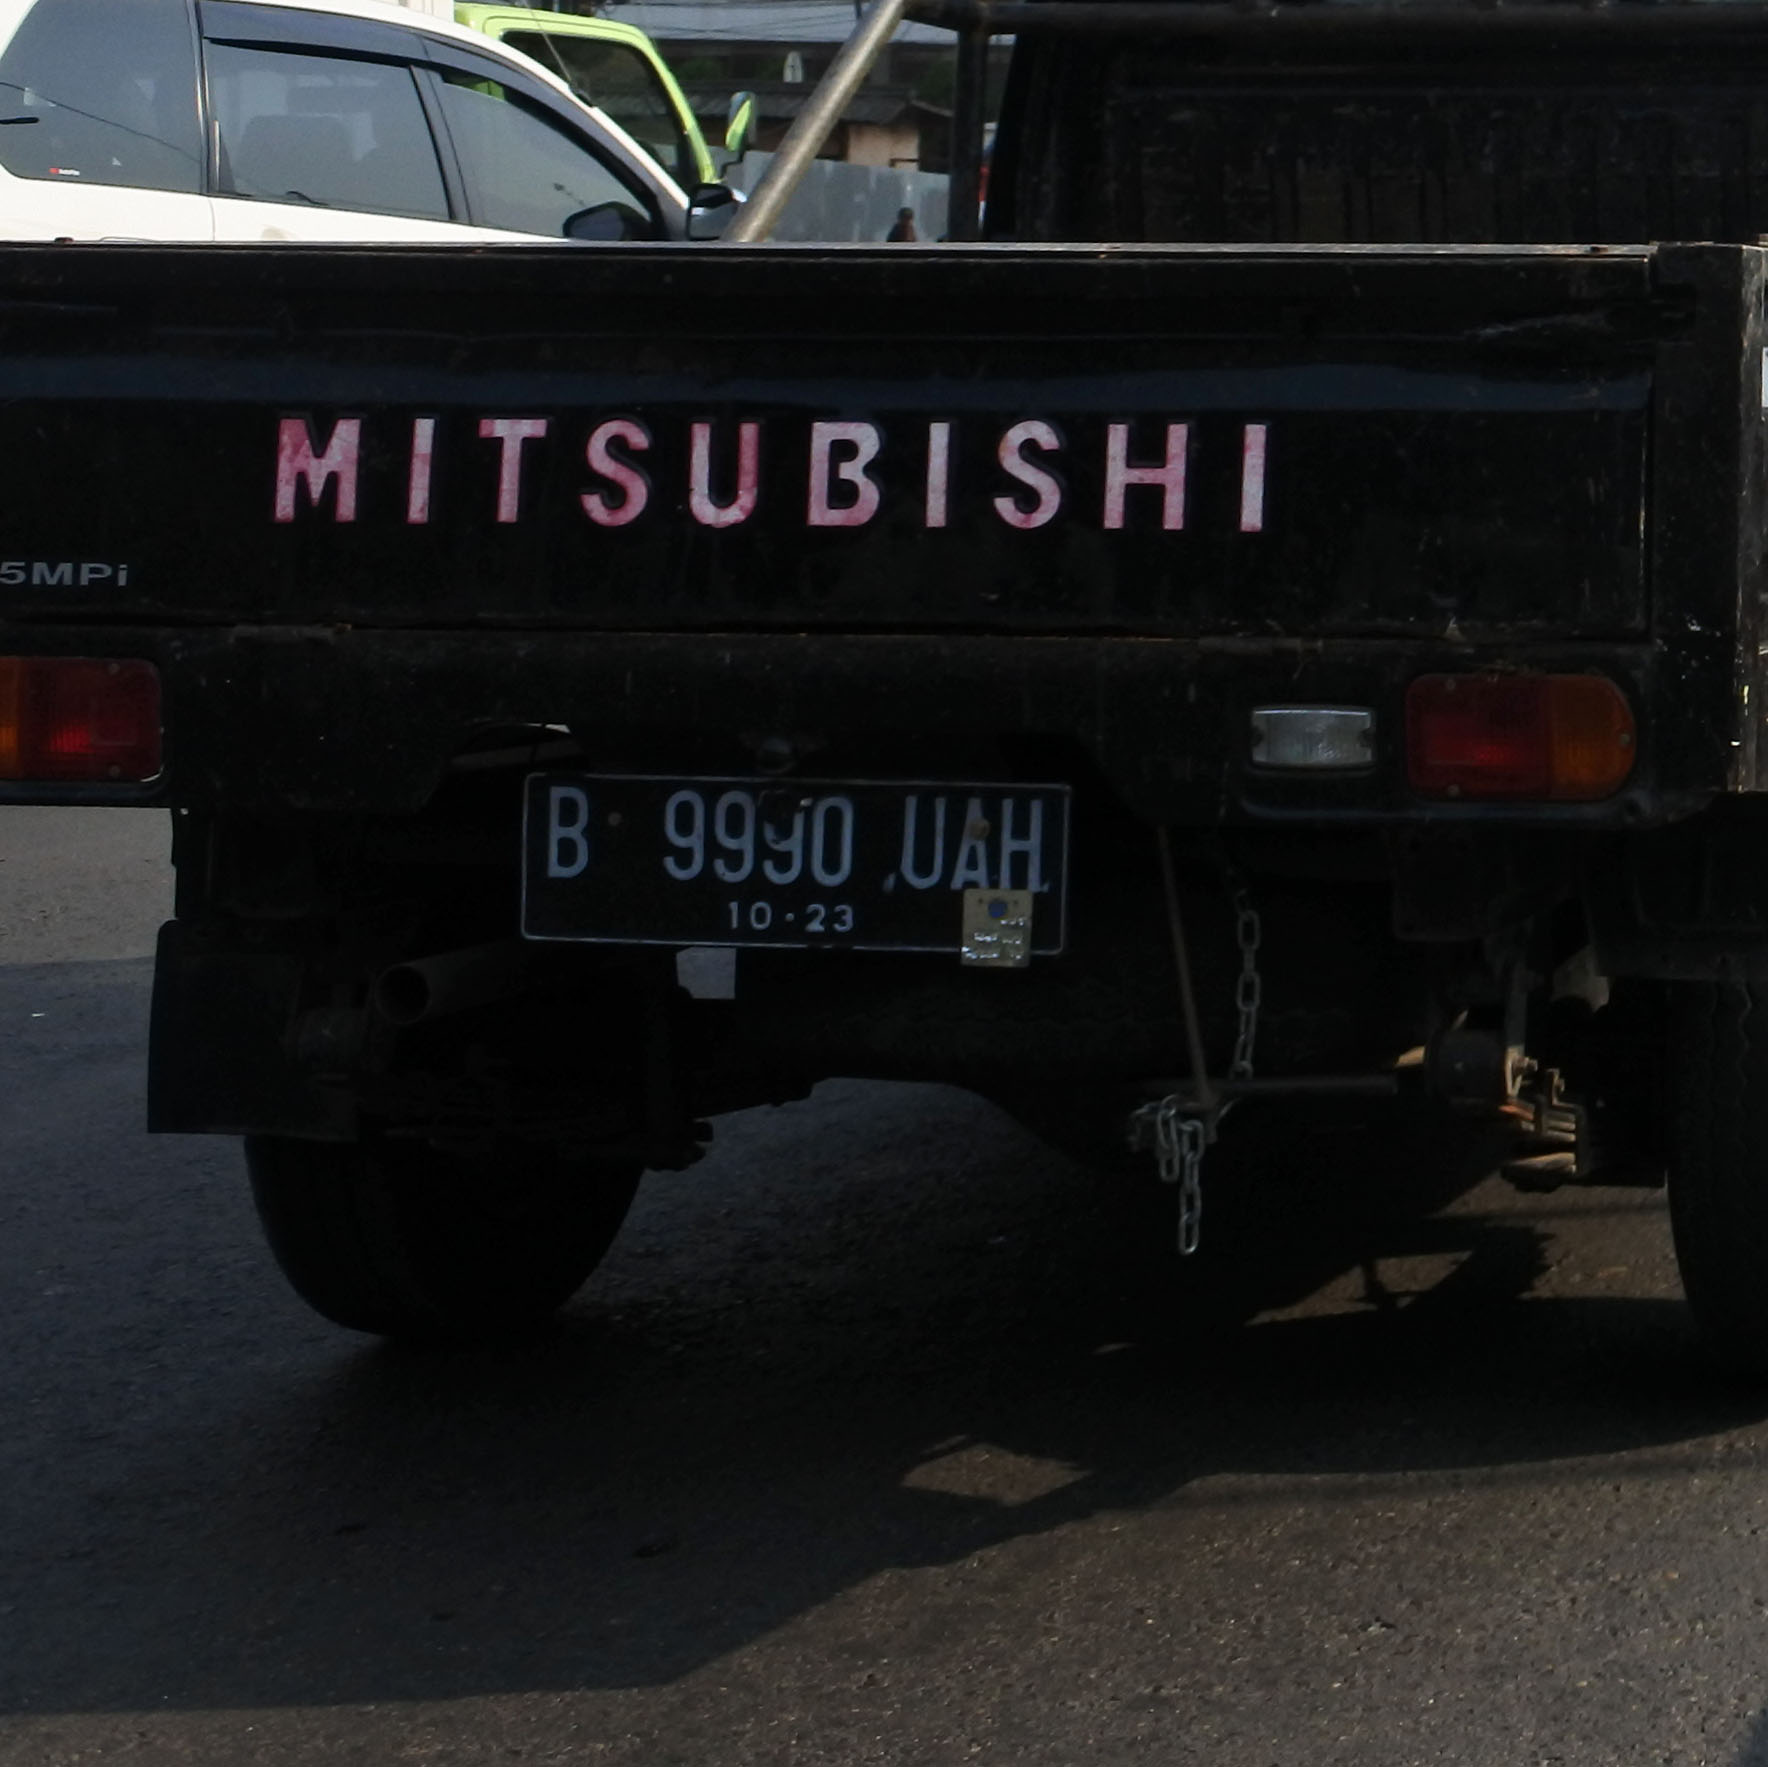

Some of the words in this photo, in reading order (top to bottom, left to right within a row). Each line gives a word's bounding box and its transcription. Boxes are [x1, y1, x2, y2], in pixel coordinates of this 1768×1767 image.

[272, 416, 1268, 531] MITSUBISHI
[546, 786, 590, 878] B
[663, 789, 854, 887] 9990
[899, 795, 1046, 892] UAH
